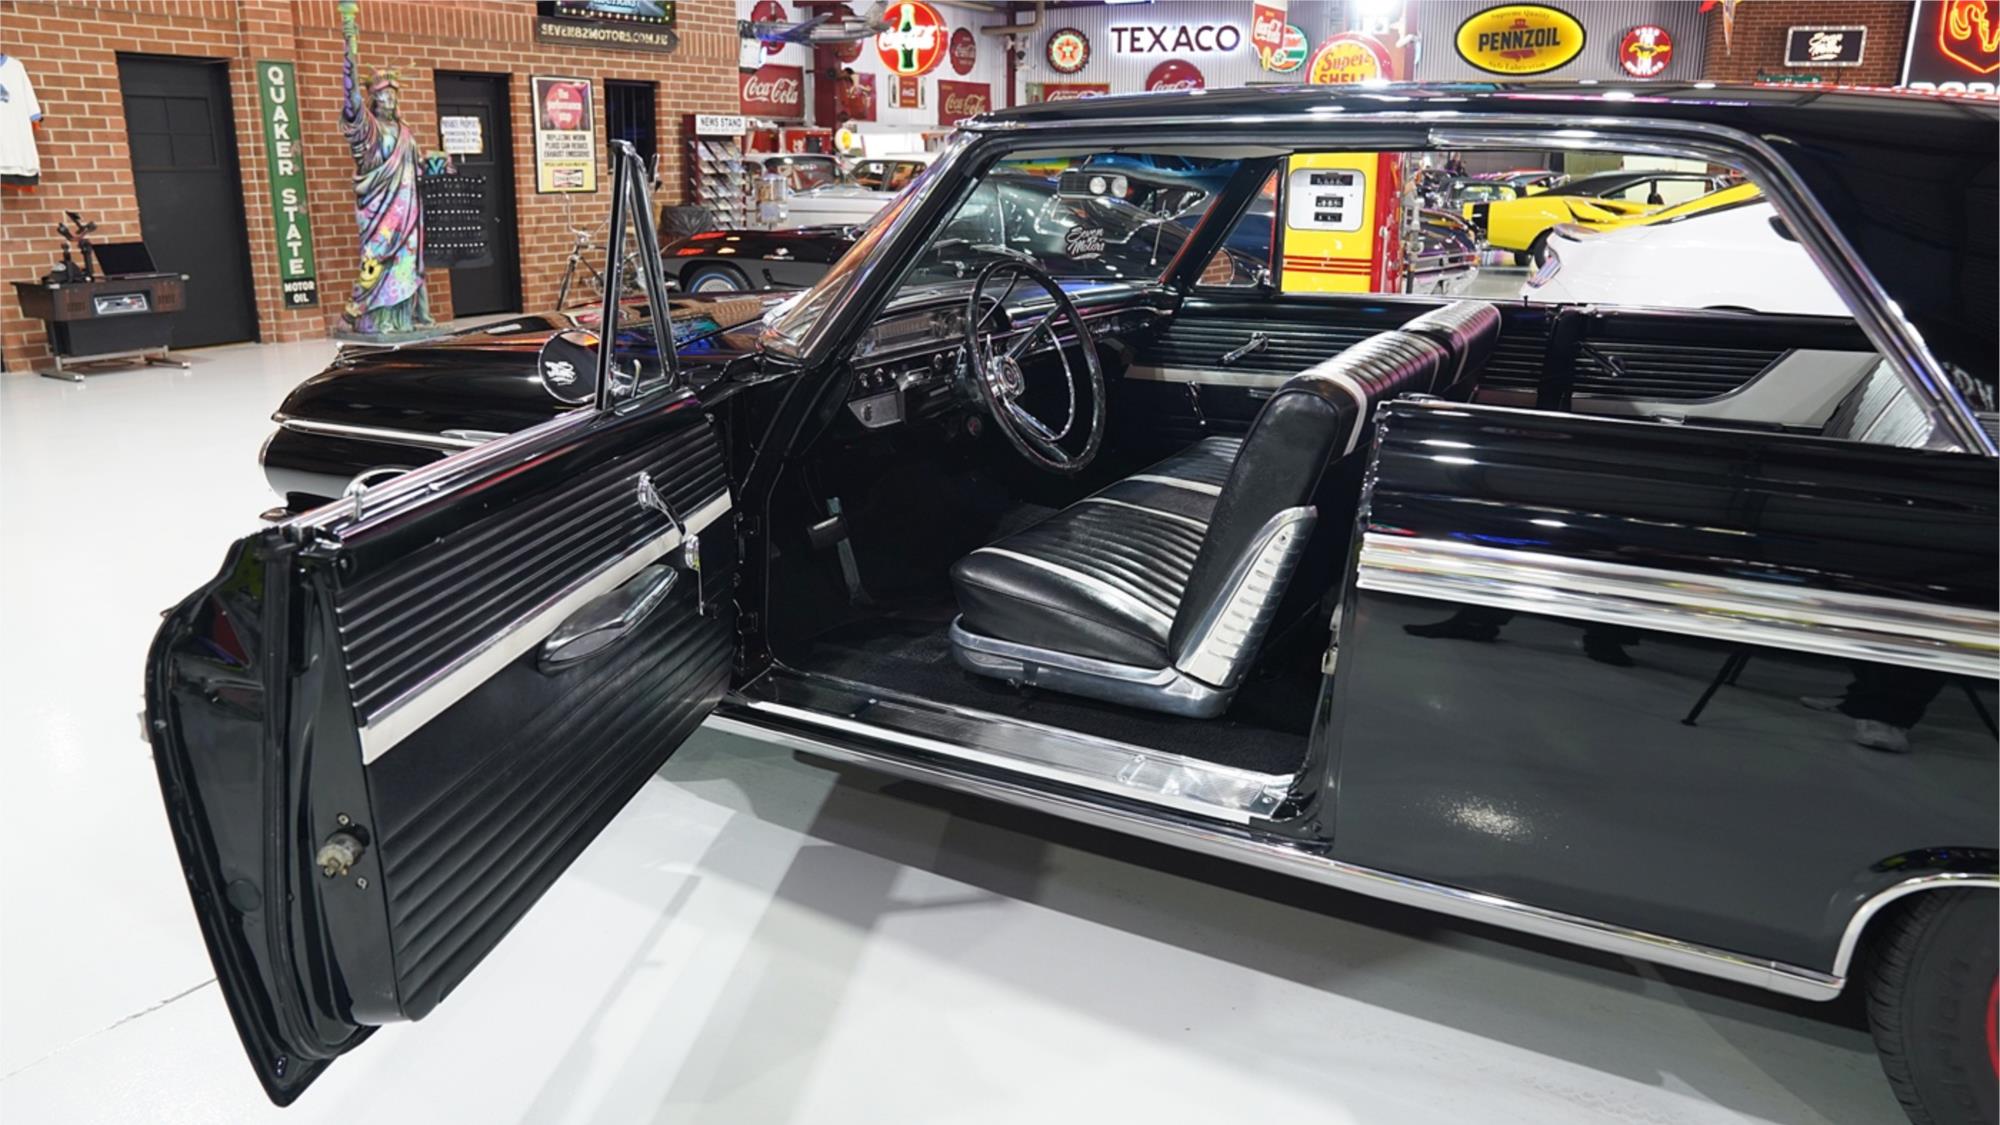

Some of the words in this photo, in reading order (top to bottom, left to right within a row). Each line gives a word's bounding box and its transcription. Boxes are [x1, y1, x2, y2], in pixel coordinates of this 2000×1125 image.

[1111, 25, 1241, 53] TEXACO
[1478, 27, 1560, 52] PENNZOIL
[743, 76, 799, 104] Coca-Cola
[268, 66, 293, 176] QUAKER
[720, 117, 742, 128] STAND
[281, 188, 305, 275] STATE
[284, 281, 315, 293] MOTOR
[293, 293, 309, 303] OIL
